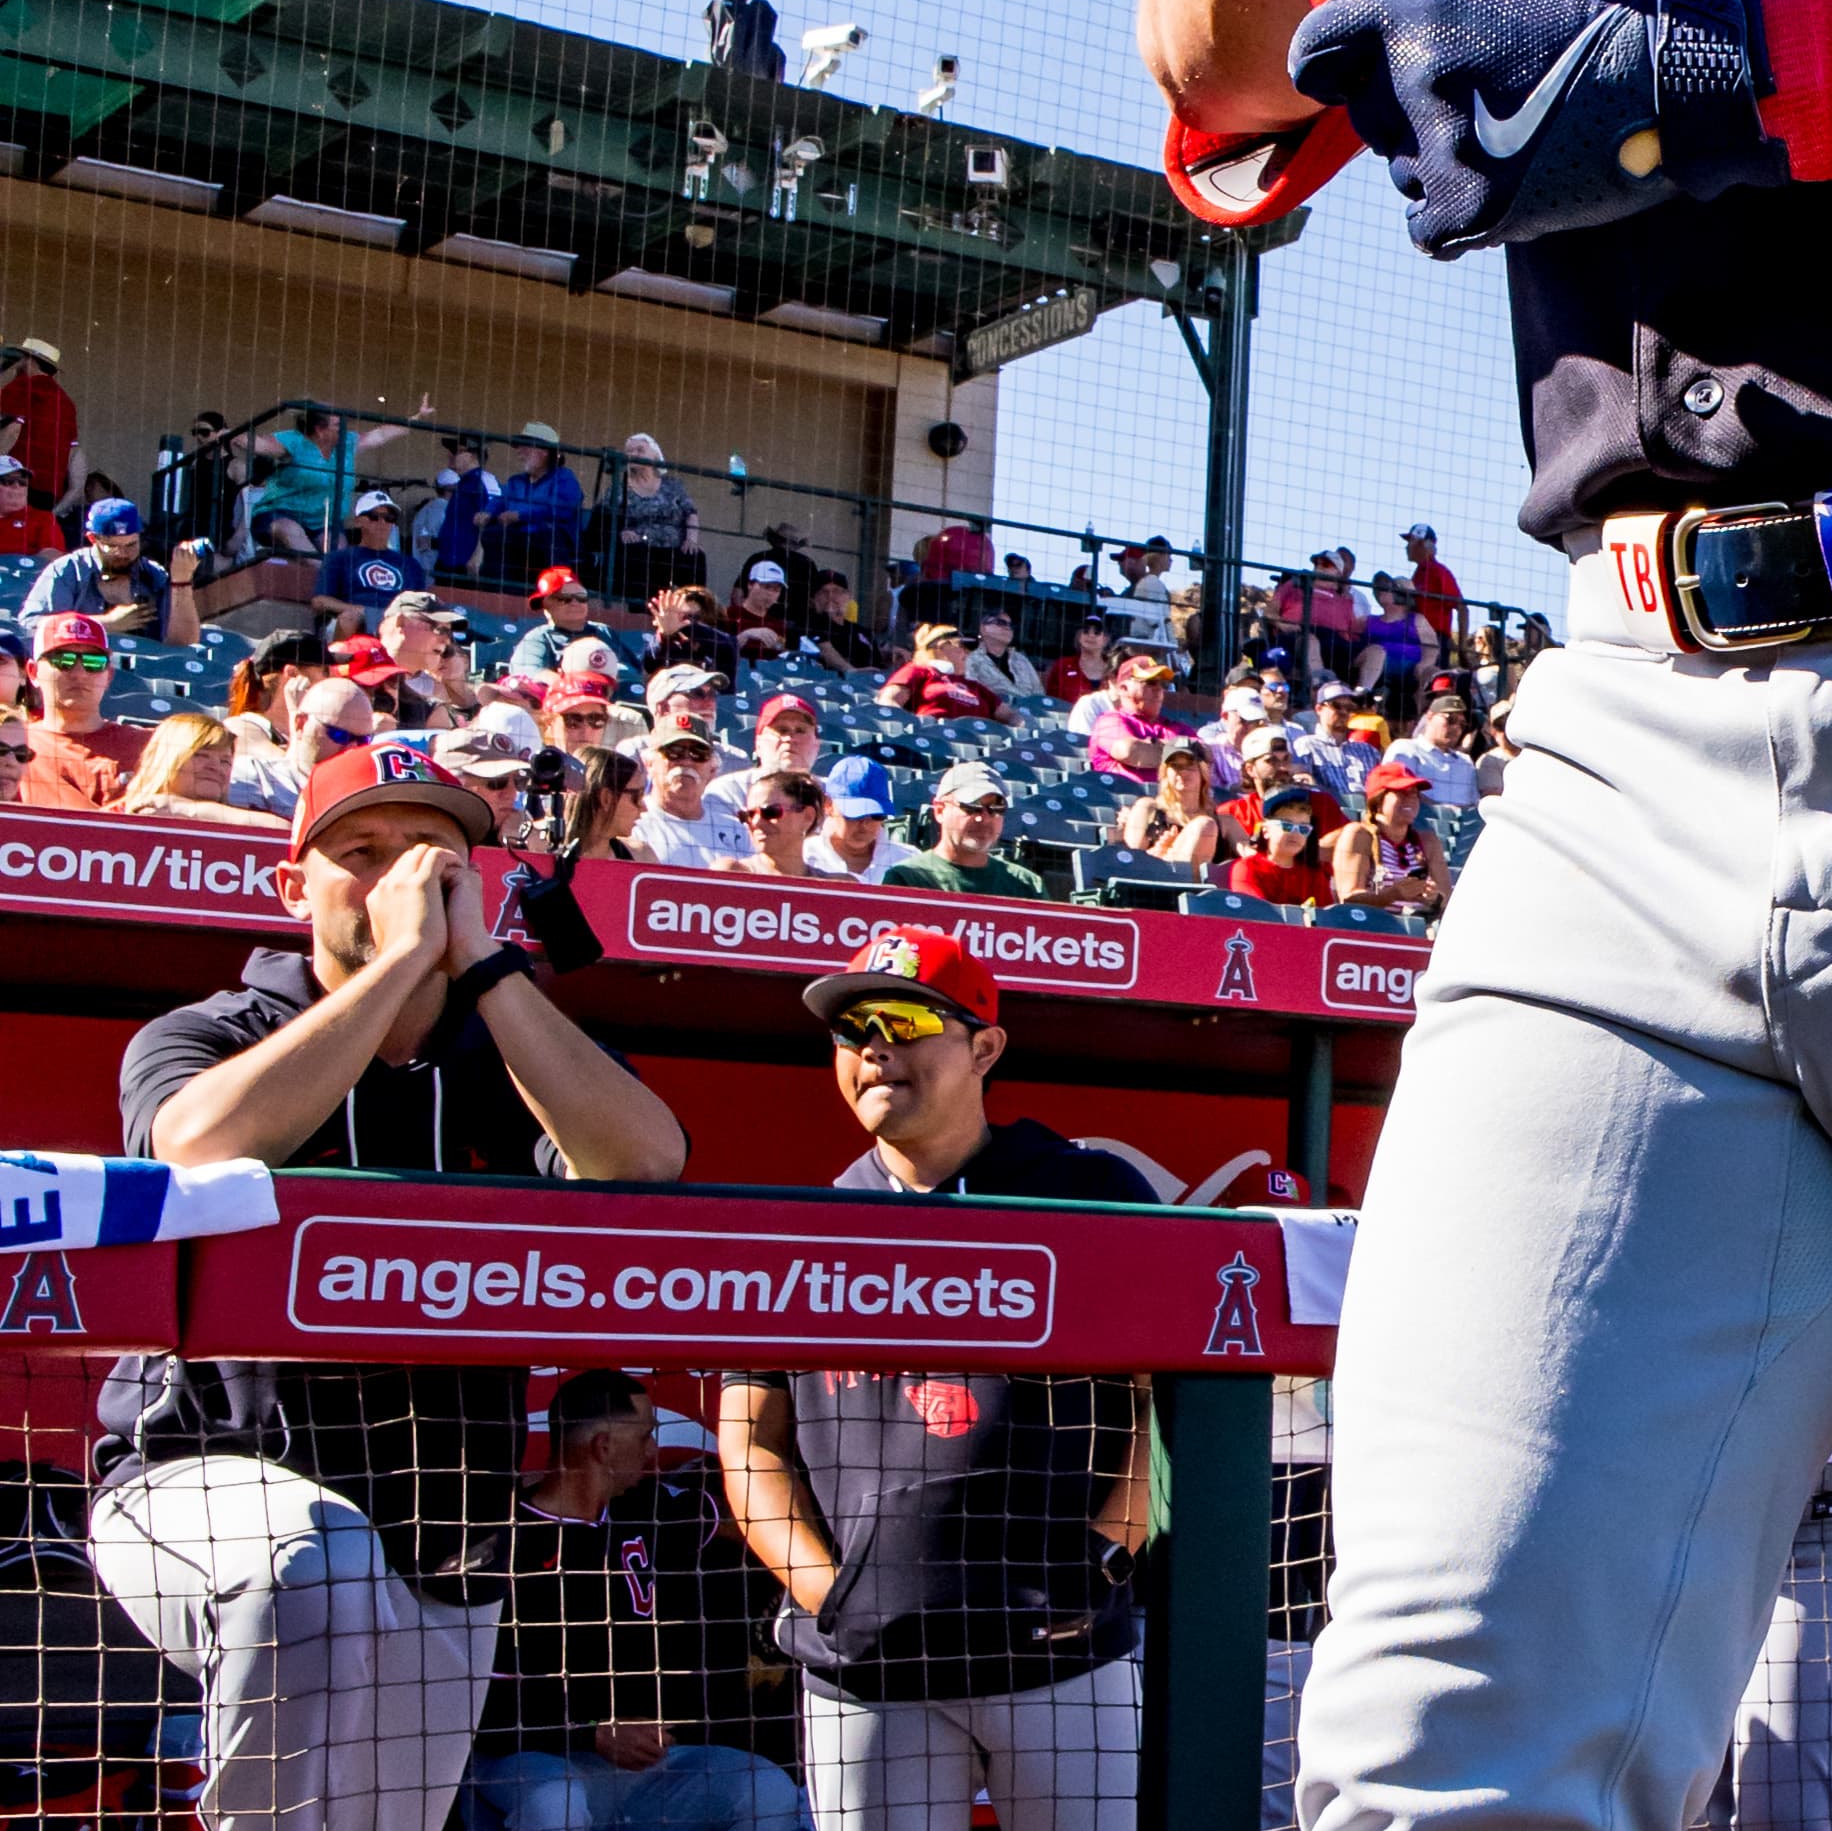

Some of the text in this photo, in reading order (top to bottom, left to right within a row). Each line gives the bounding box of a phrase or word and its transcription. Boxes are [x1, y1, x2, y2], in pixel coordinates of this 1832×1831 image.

[967, 292, 1089, 367] CONCESSIONS
[1609, 541, 1657, 614] TB
[0, 842, 278, 897] com/tick
[648, 898, 1125, 970] angels.co/tickets
[318, 1250, 1037, 1319] angels.com/tickets
